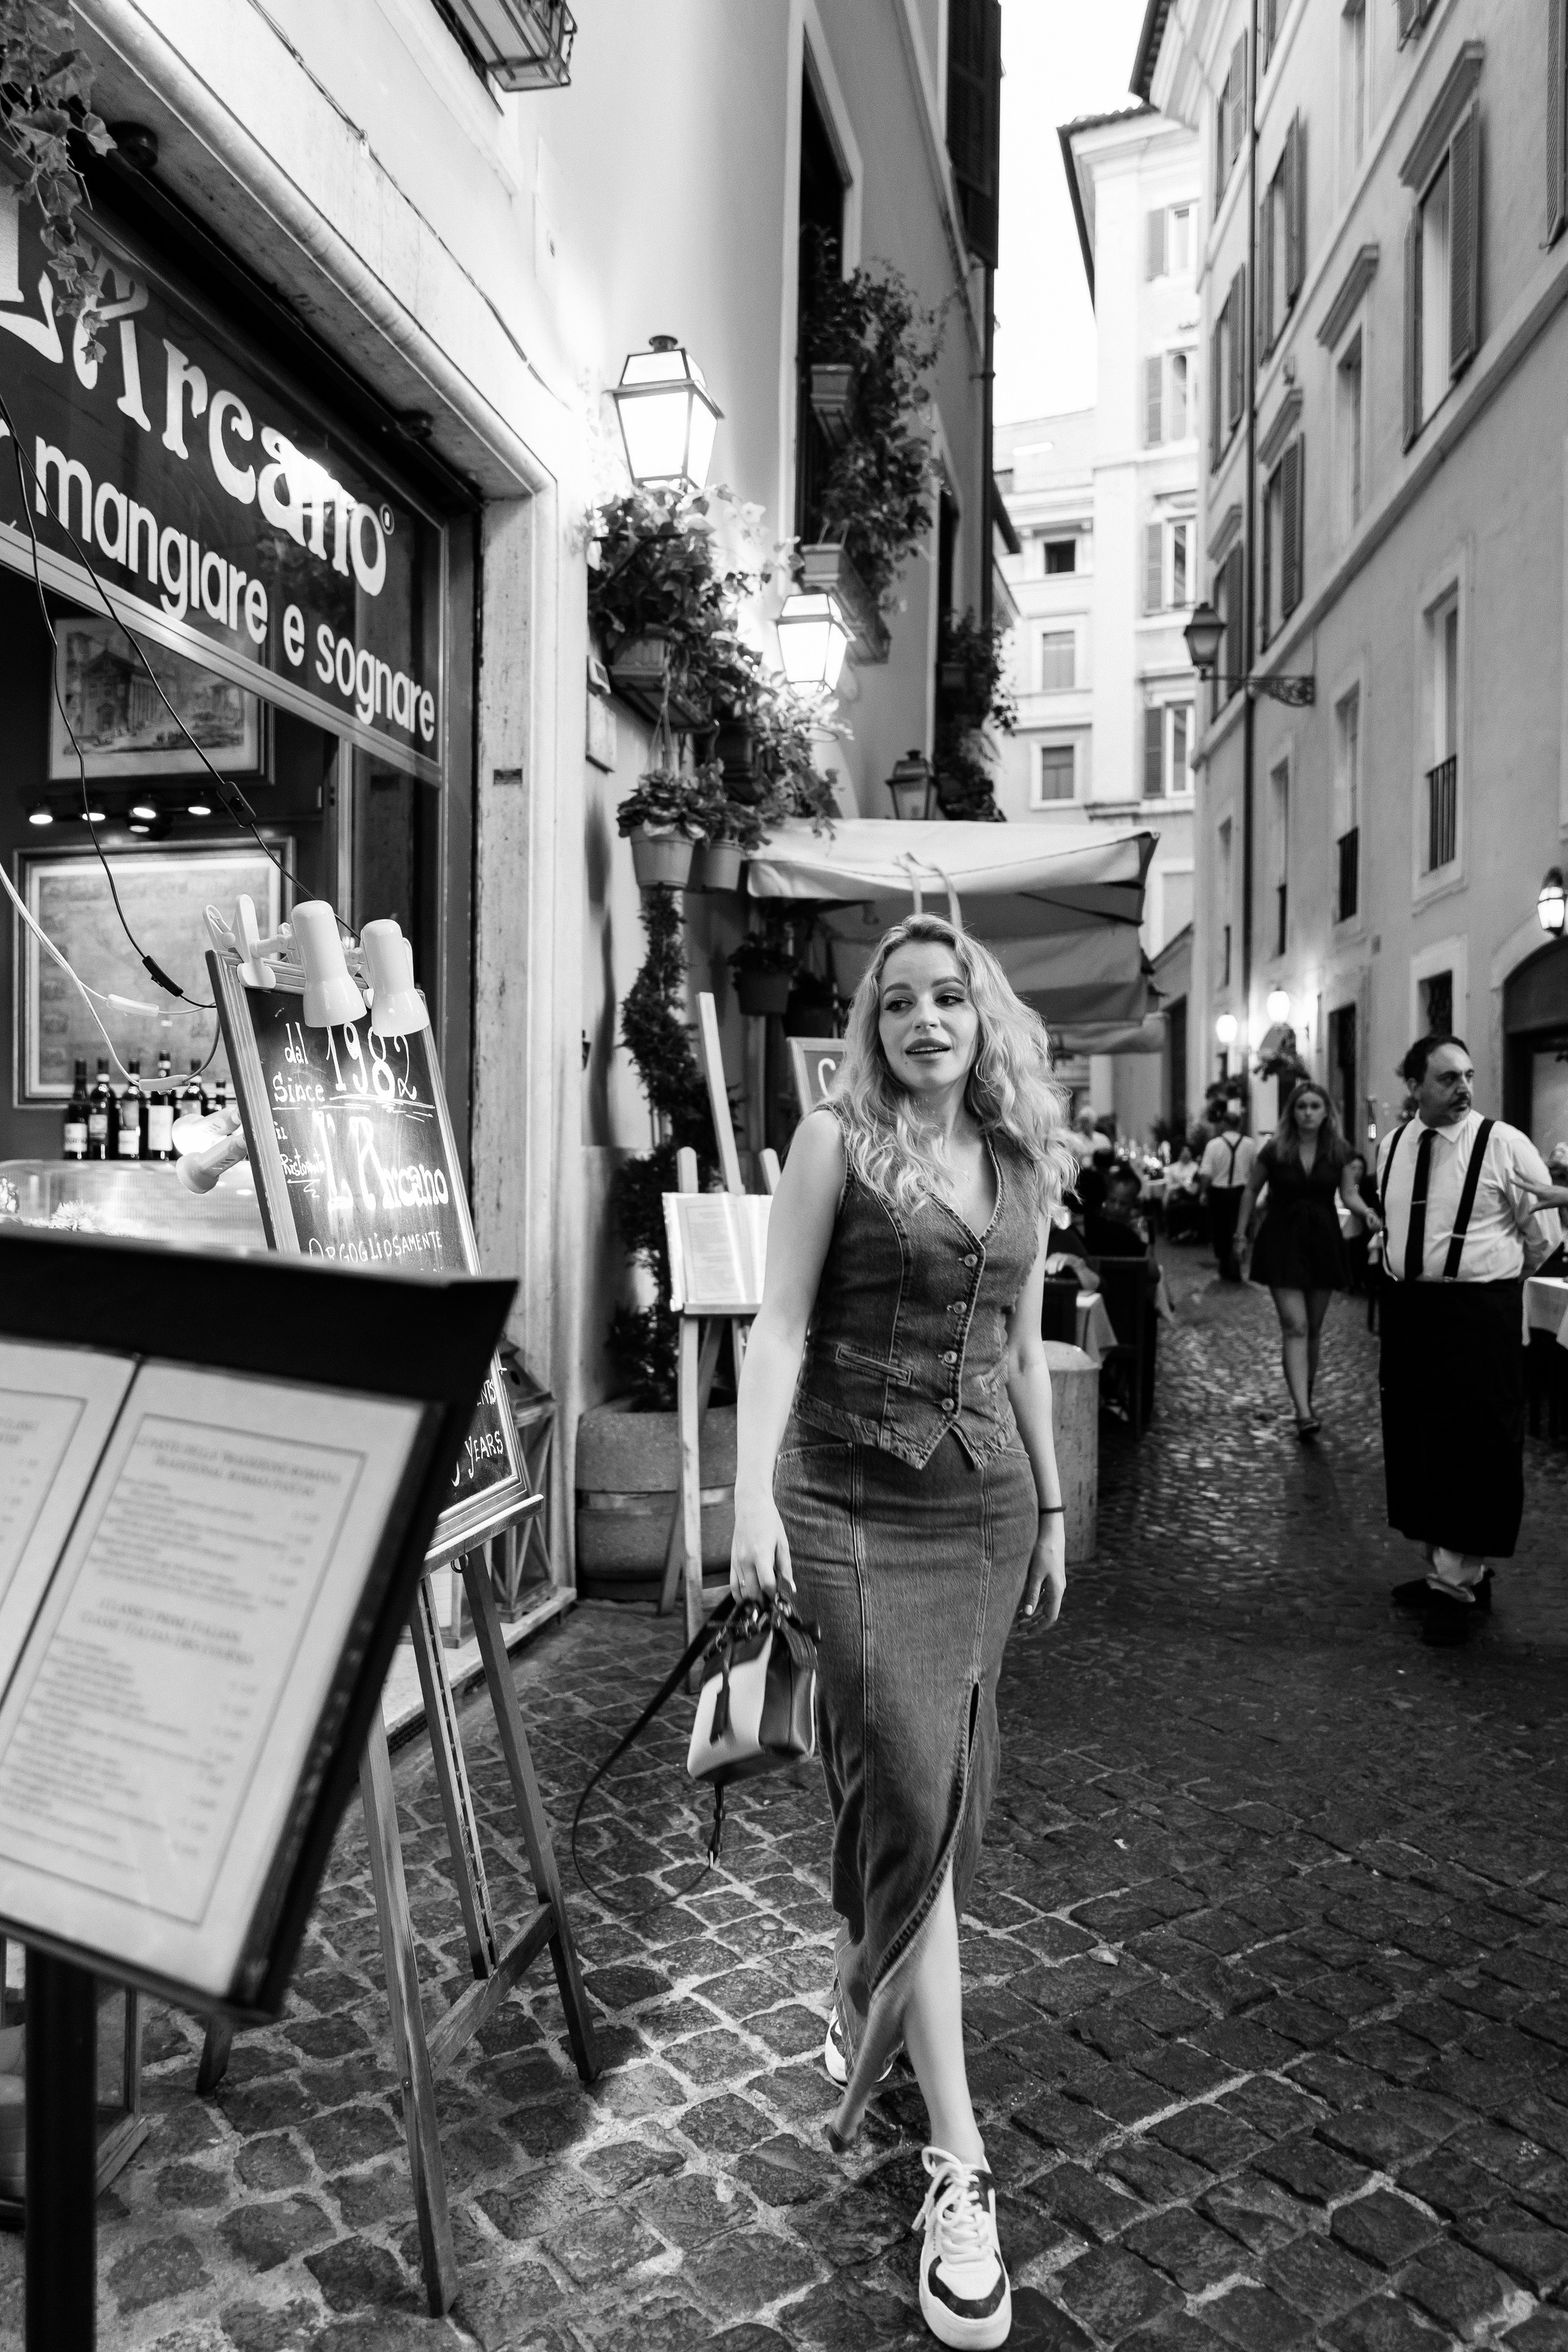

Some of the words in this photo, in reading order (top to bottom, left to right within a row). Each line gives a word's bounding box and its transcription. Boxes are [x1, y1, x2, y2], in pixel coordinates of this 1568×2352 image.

[36, 435, 268, 644] mangiare
[283, 604, 305, 666] e
[315, 623, 435, 742] sognare
[273, 1071, 326, 1103] Since
[325, 1022, 417, 1101] 1982
[284, 1021, 309, 1065] dal
